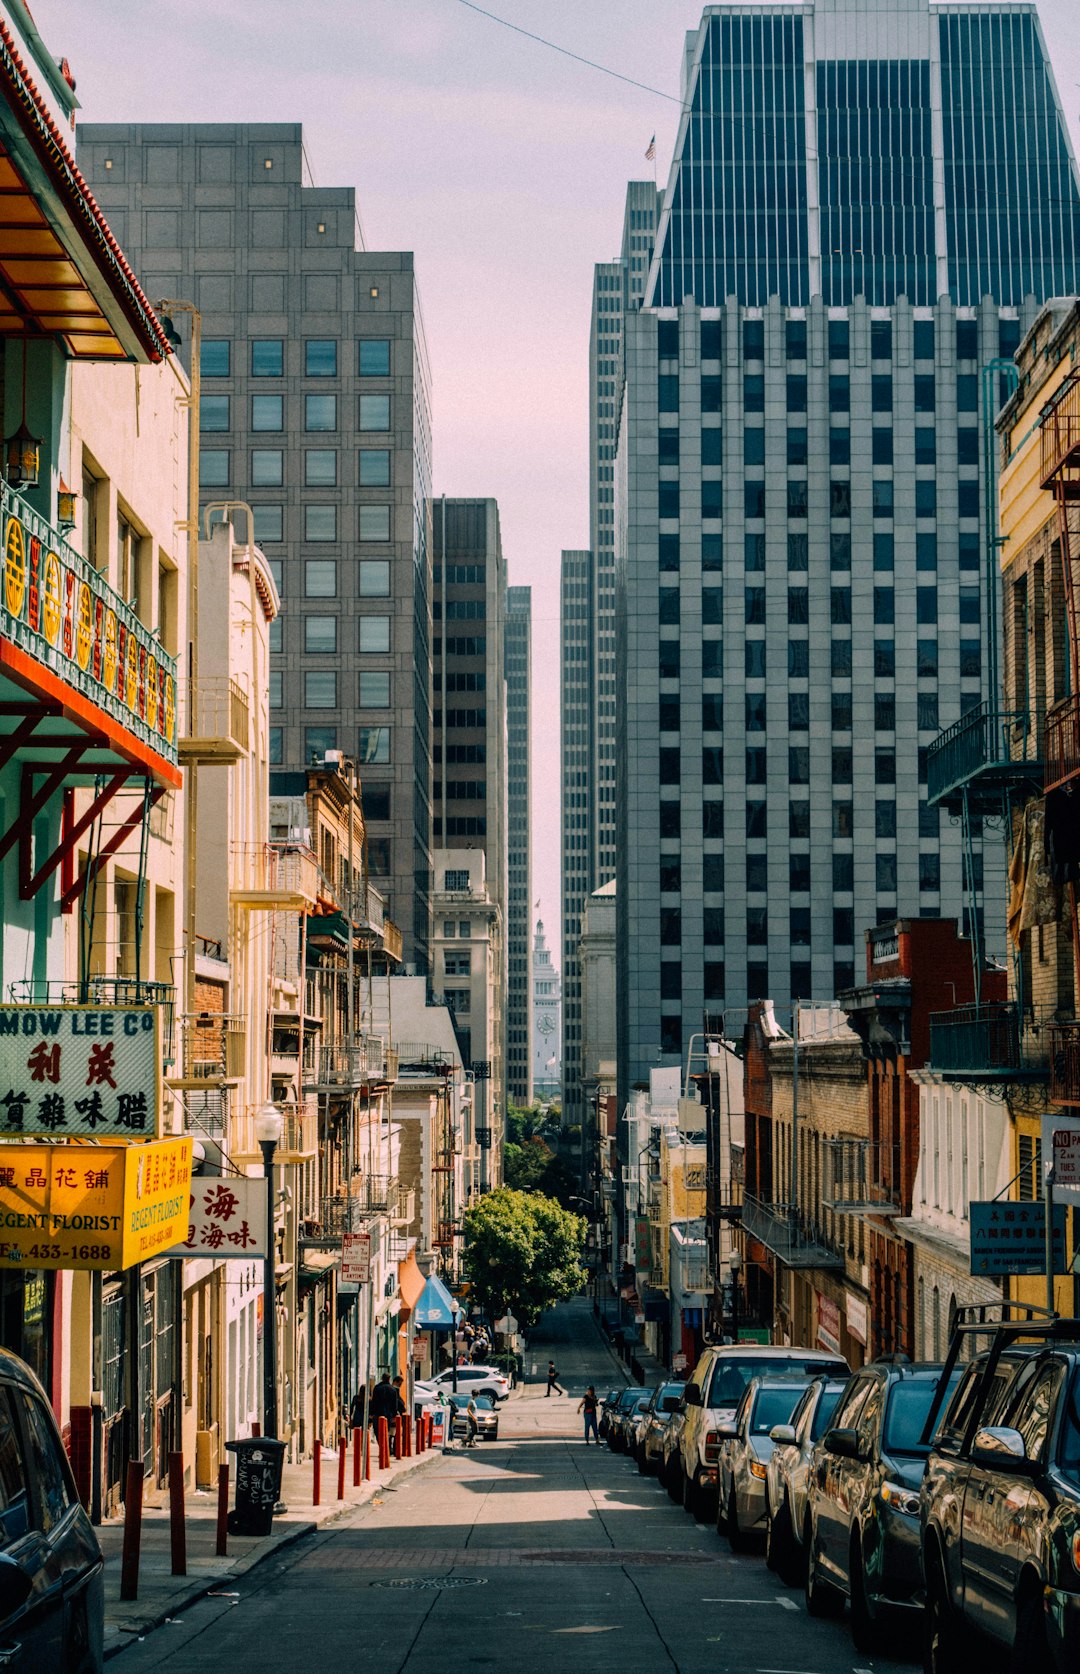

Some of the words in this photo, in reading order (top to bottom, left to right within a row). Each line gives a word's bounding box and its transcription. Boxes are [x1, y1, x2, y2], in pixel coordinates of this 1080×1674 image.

[0, 1013, 62, 1036] MOW
[72, 1013, 113, 1036] LEE
[1055, 1132, 1069, 1147] NO
[1060, 1163, 1075, 1172] TUES
[131, 1204, 157, 1232] REGENT
[157, 1195, 184, 1223] FLORIST
[53, 1214, 121, 1230] FLORIST
[344, 1239, 352, 1247] NO
